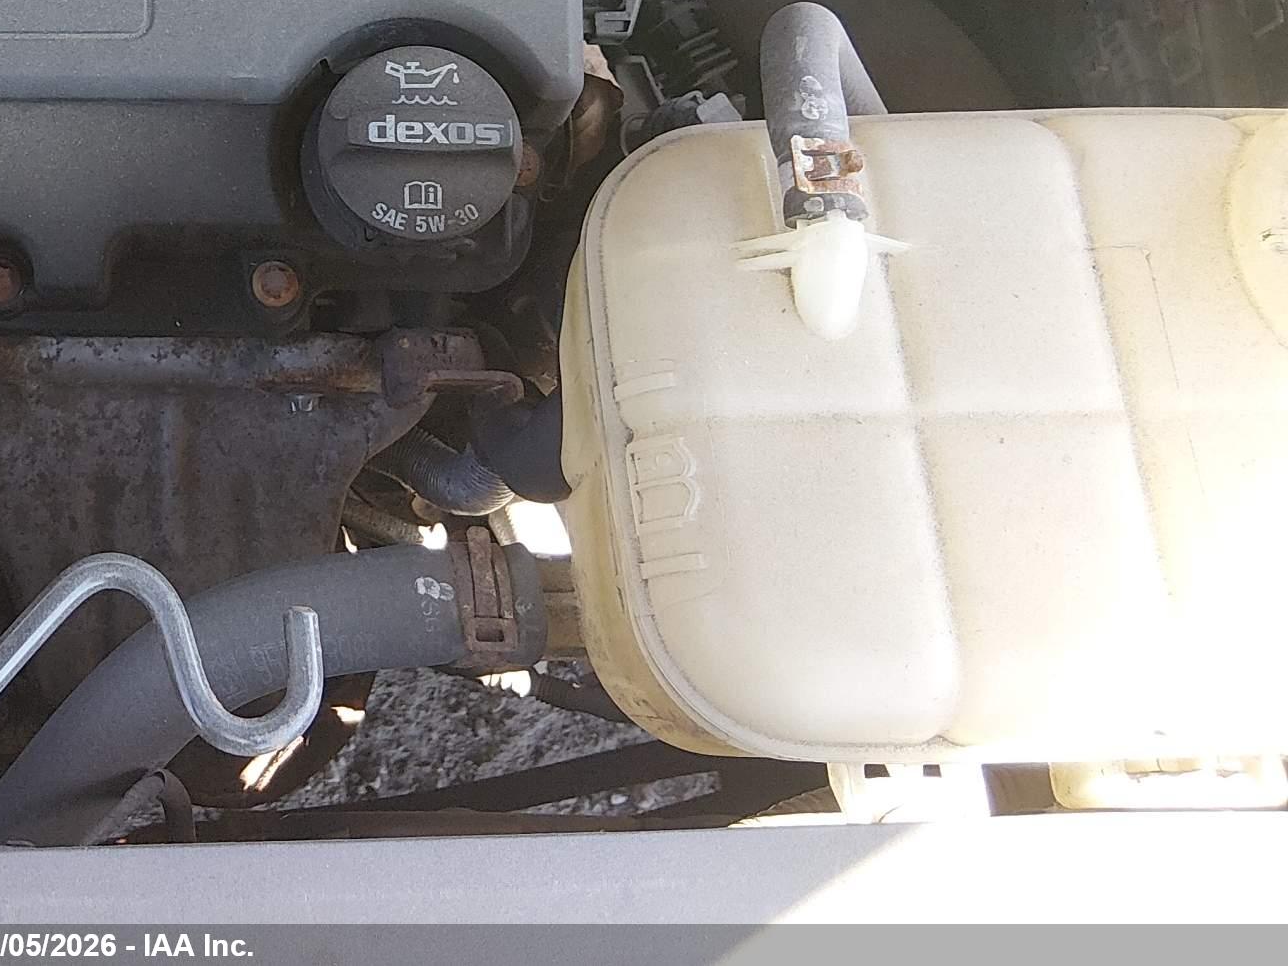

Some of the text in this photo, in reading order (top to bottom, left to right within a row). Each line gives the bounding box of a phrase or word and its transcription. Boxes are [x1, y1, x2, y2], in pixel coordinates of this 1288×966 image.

[367, 114, 505, 145] dexos
[371, 202, 480, 233] SAE 5W-30
